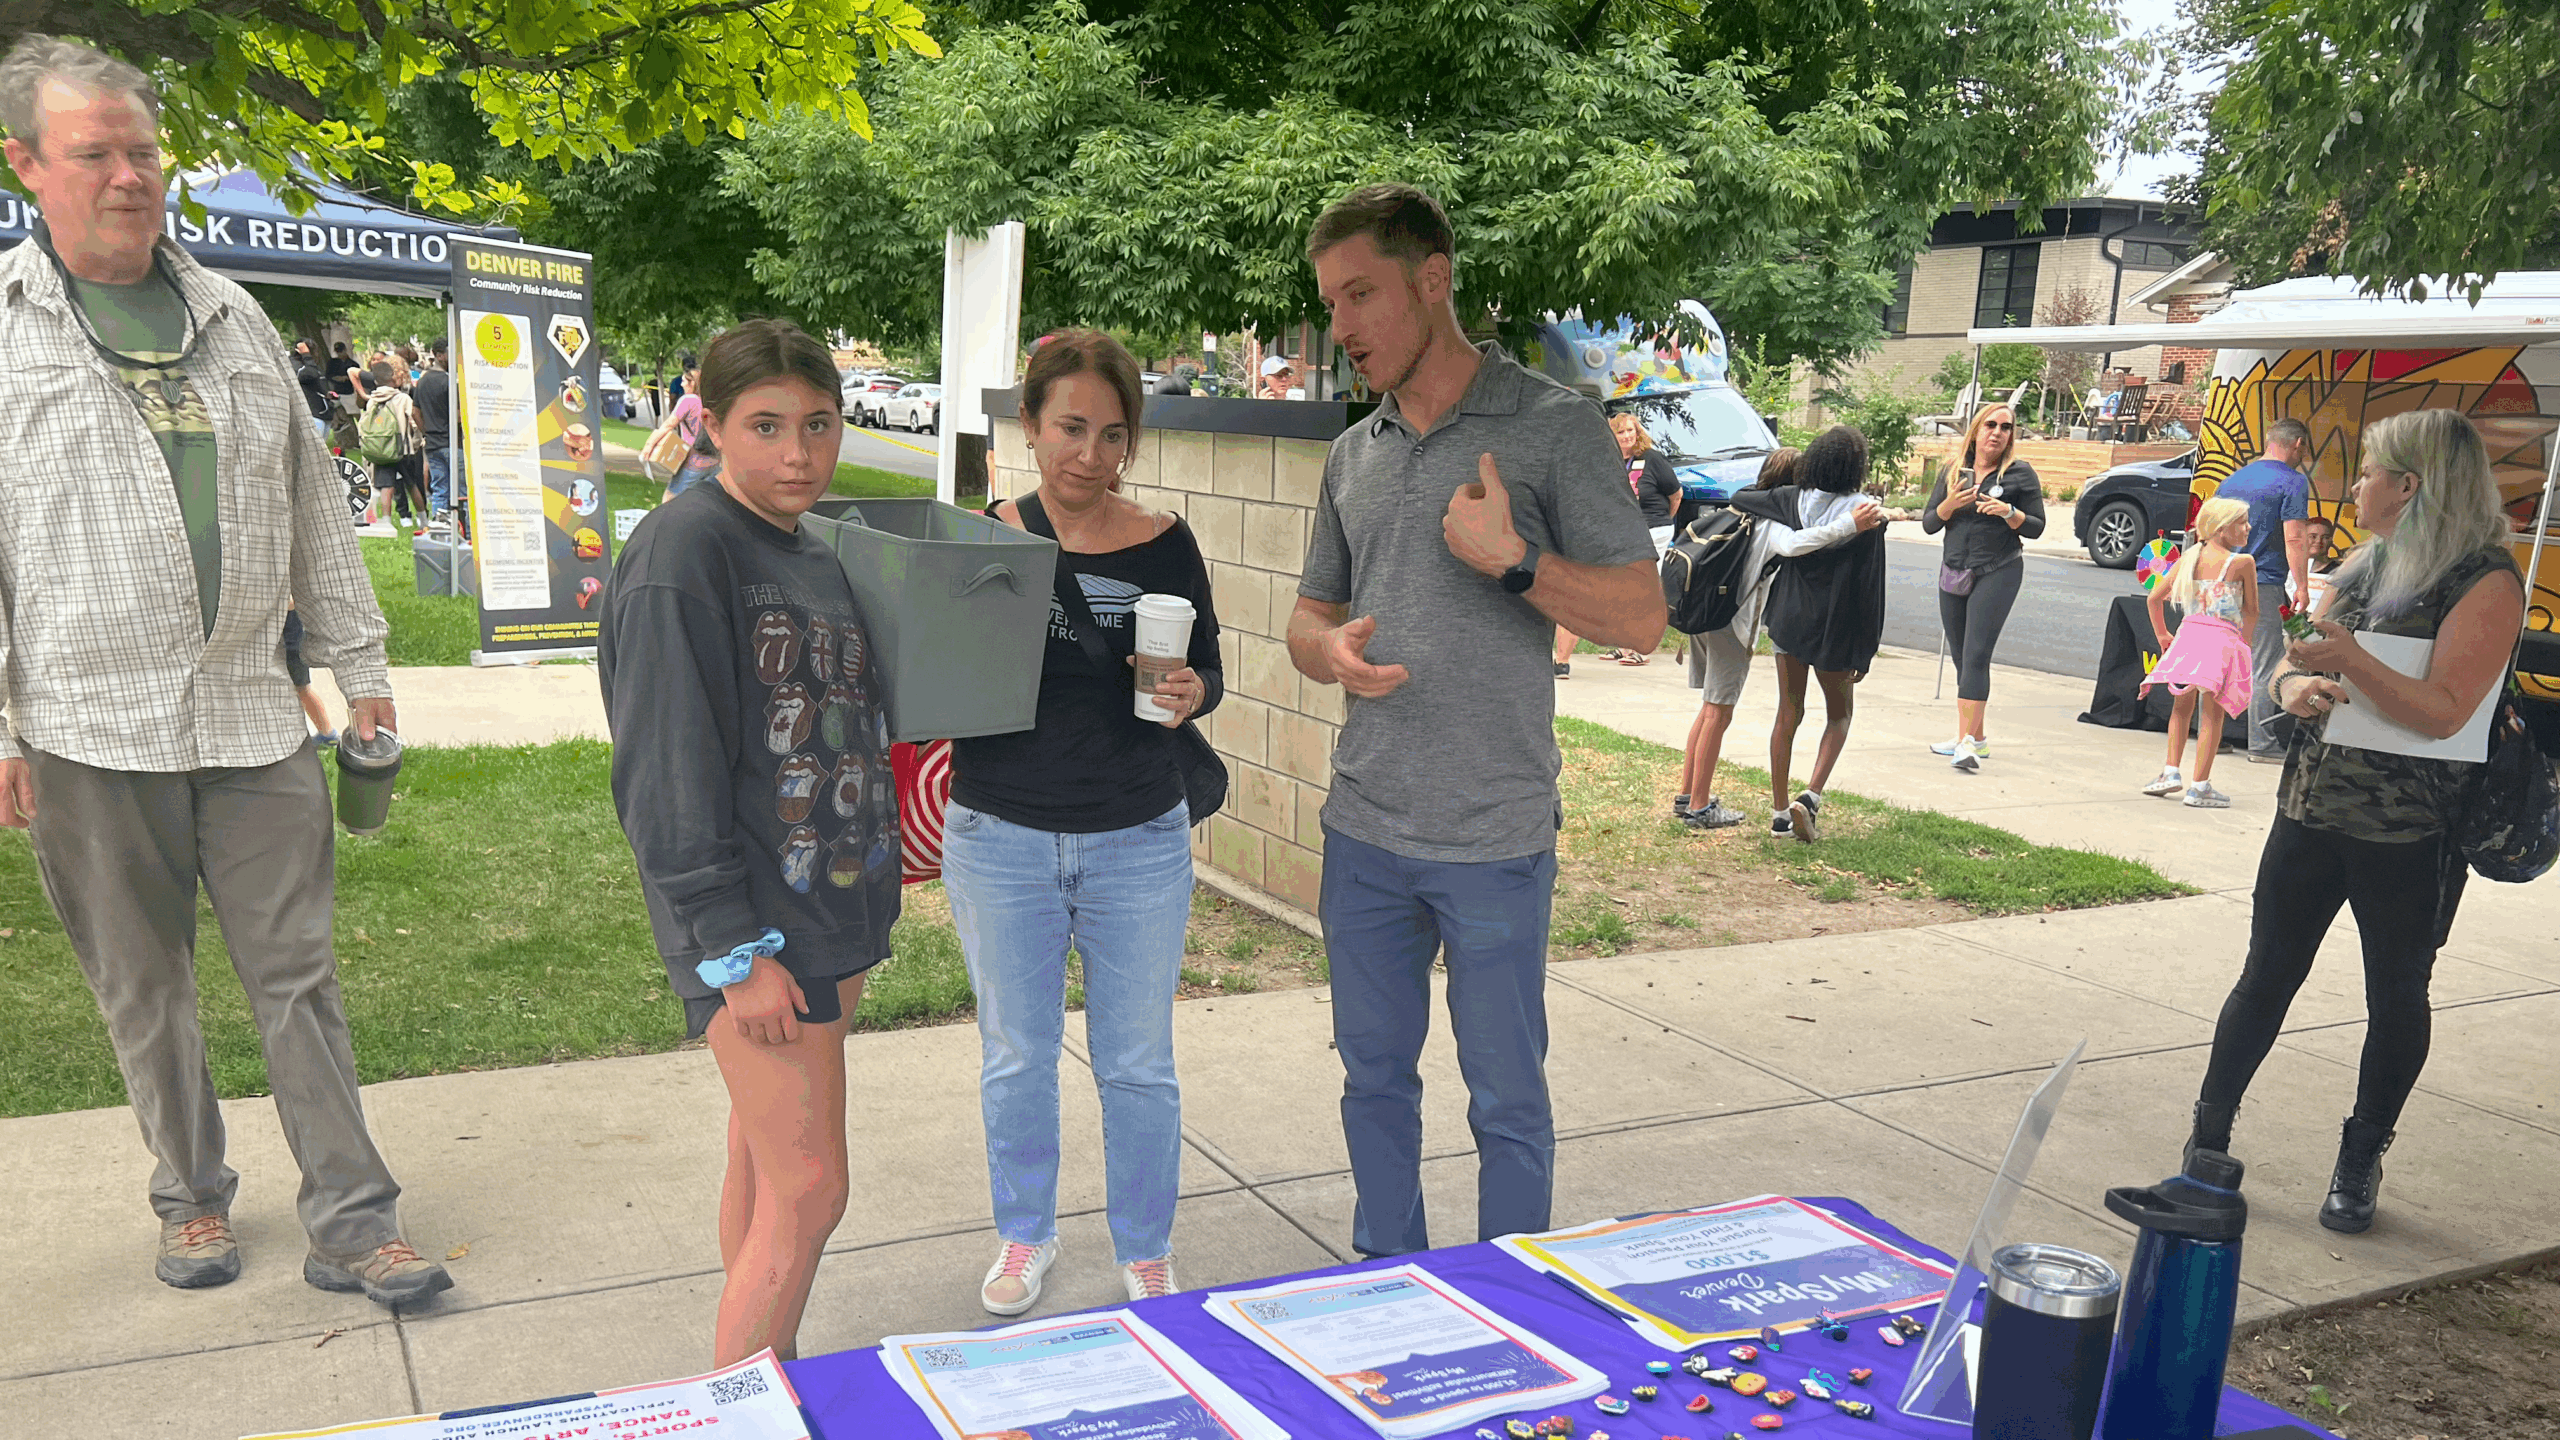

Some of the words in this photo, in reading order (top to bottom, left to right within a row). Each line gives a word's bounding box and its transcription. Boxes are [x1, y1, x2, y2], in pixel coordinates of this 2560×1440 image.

[165, 211, 234, 245] ISK
[248, 218, 448, 263] REDUCTIO
[466, 250, 543, 279] DENVER
[545, 261, 584, 285] FIRE
[469, 277, 521, 294] Community
[522, 284, 540, 295] Risk
[541, 286, 583, 300] Reduction
[493, 326, 502, 340] 5
[740, 583, 784, 608] THE
[1667, 1234, 1701, 1245] Your
[1700, 1224, 1733, 1237] Find
[1718, 1228, 1768, 1244] Pursue
[1623, 1240, 1666, 1252] Spark
[1685, 1240, 1720, 1250] Your
[1685, 1250, 1770, 1269] $1,000
[1680, 1272, 1765, 1300] Denver
[1719, 1271, 1893, 1315] MySpark
[444, 1402, 613, 1433] MYSPARKDENVER.ORG
[559, 1399, 675, 1424] APPLICATIONS
[599, 1409, 691, 1430] DANCE,
[485, 1420, 552, 1436] LAUNCH
[614, 1416, 720, 1440] SPORTS,
